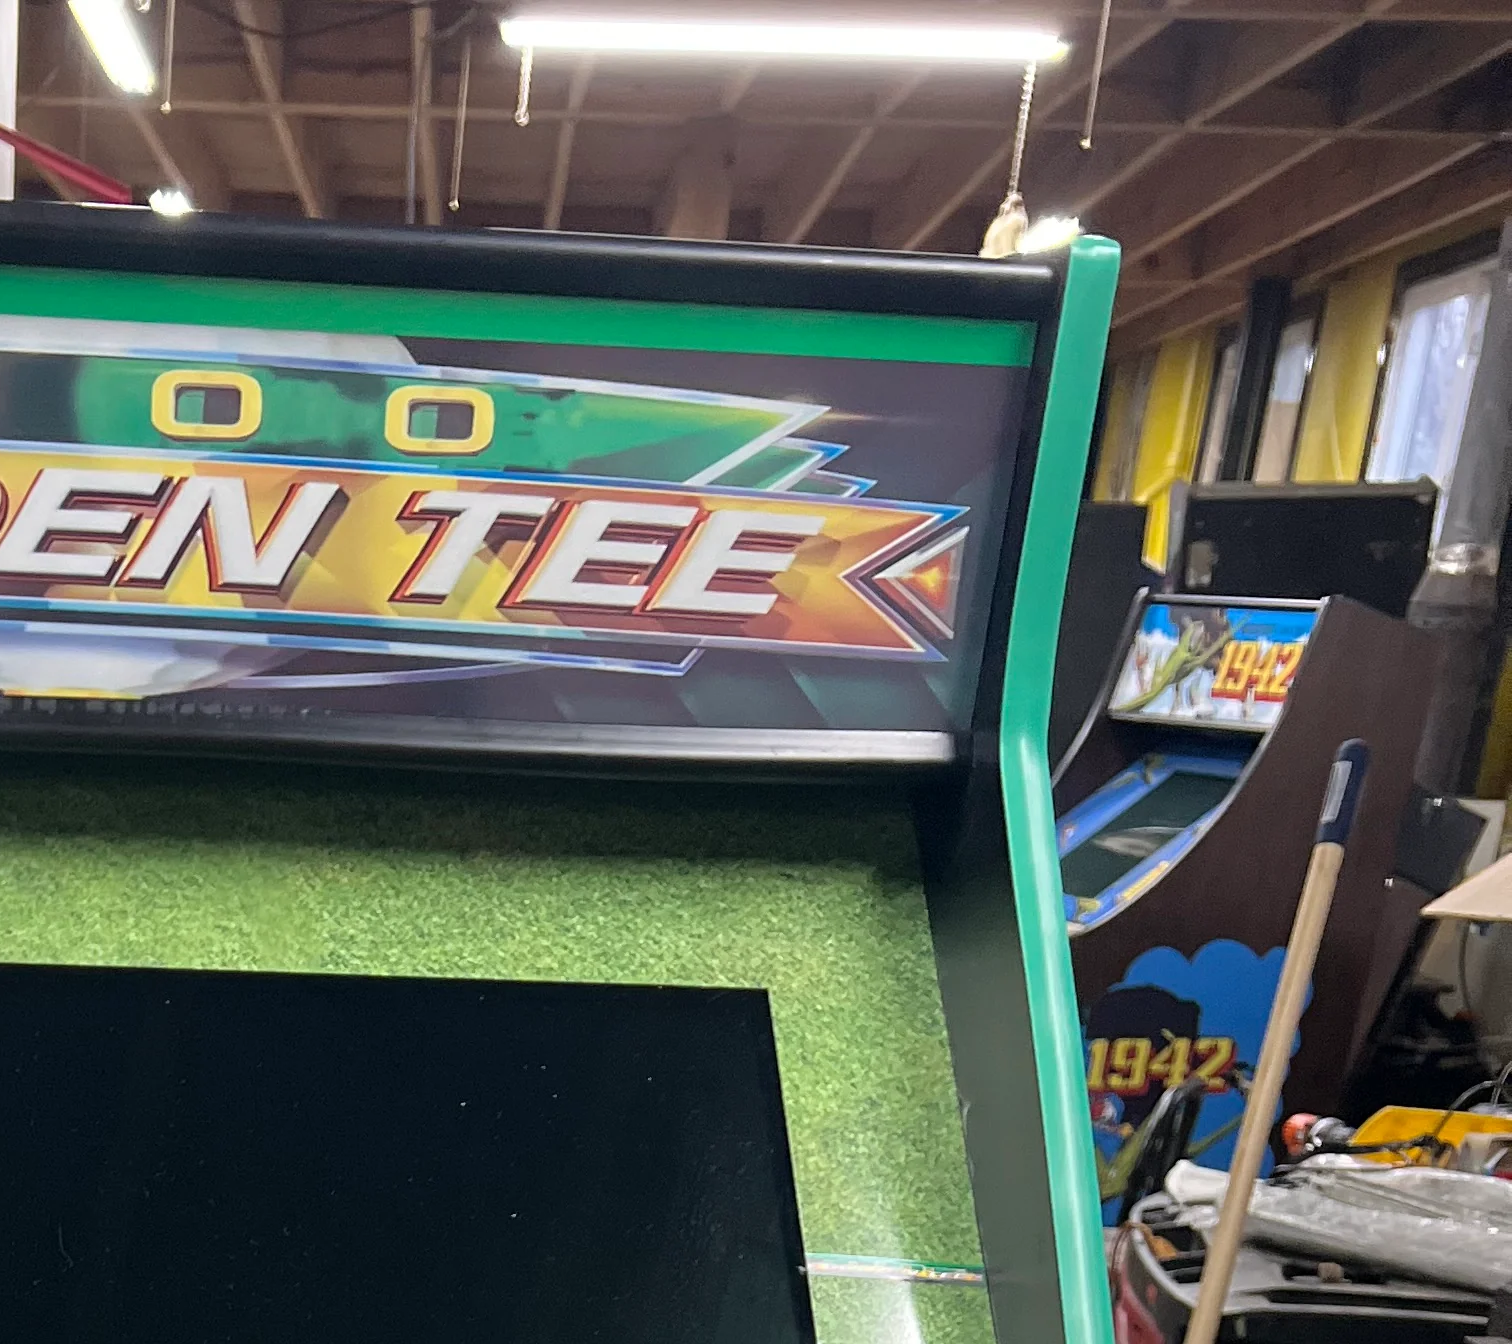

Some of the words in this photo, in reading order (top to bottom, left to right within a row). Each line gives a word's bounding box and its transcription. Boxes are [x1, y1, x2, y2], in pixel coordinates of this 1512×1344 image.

[388, 489, 828, 618] TEE
[1210, 639, 1306, 702] 1942
[1087, 1036, 1238, 1095] 1942
